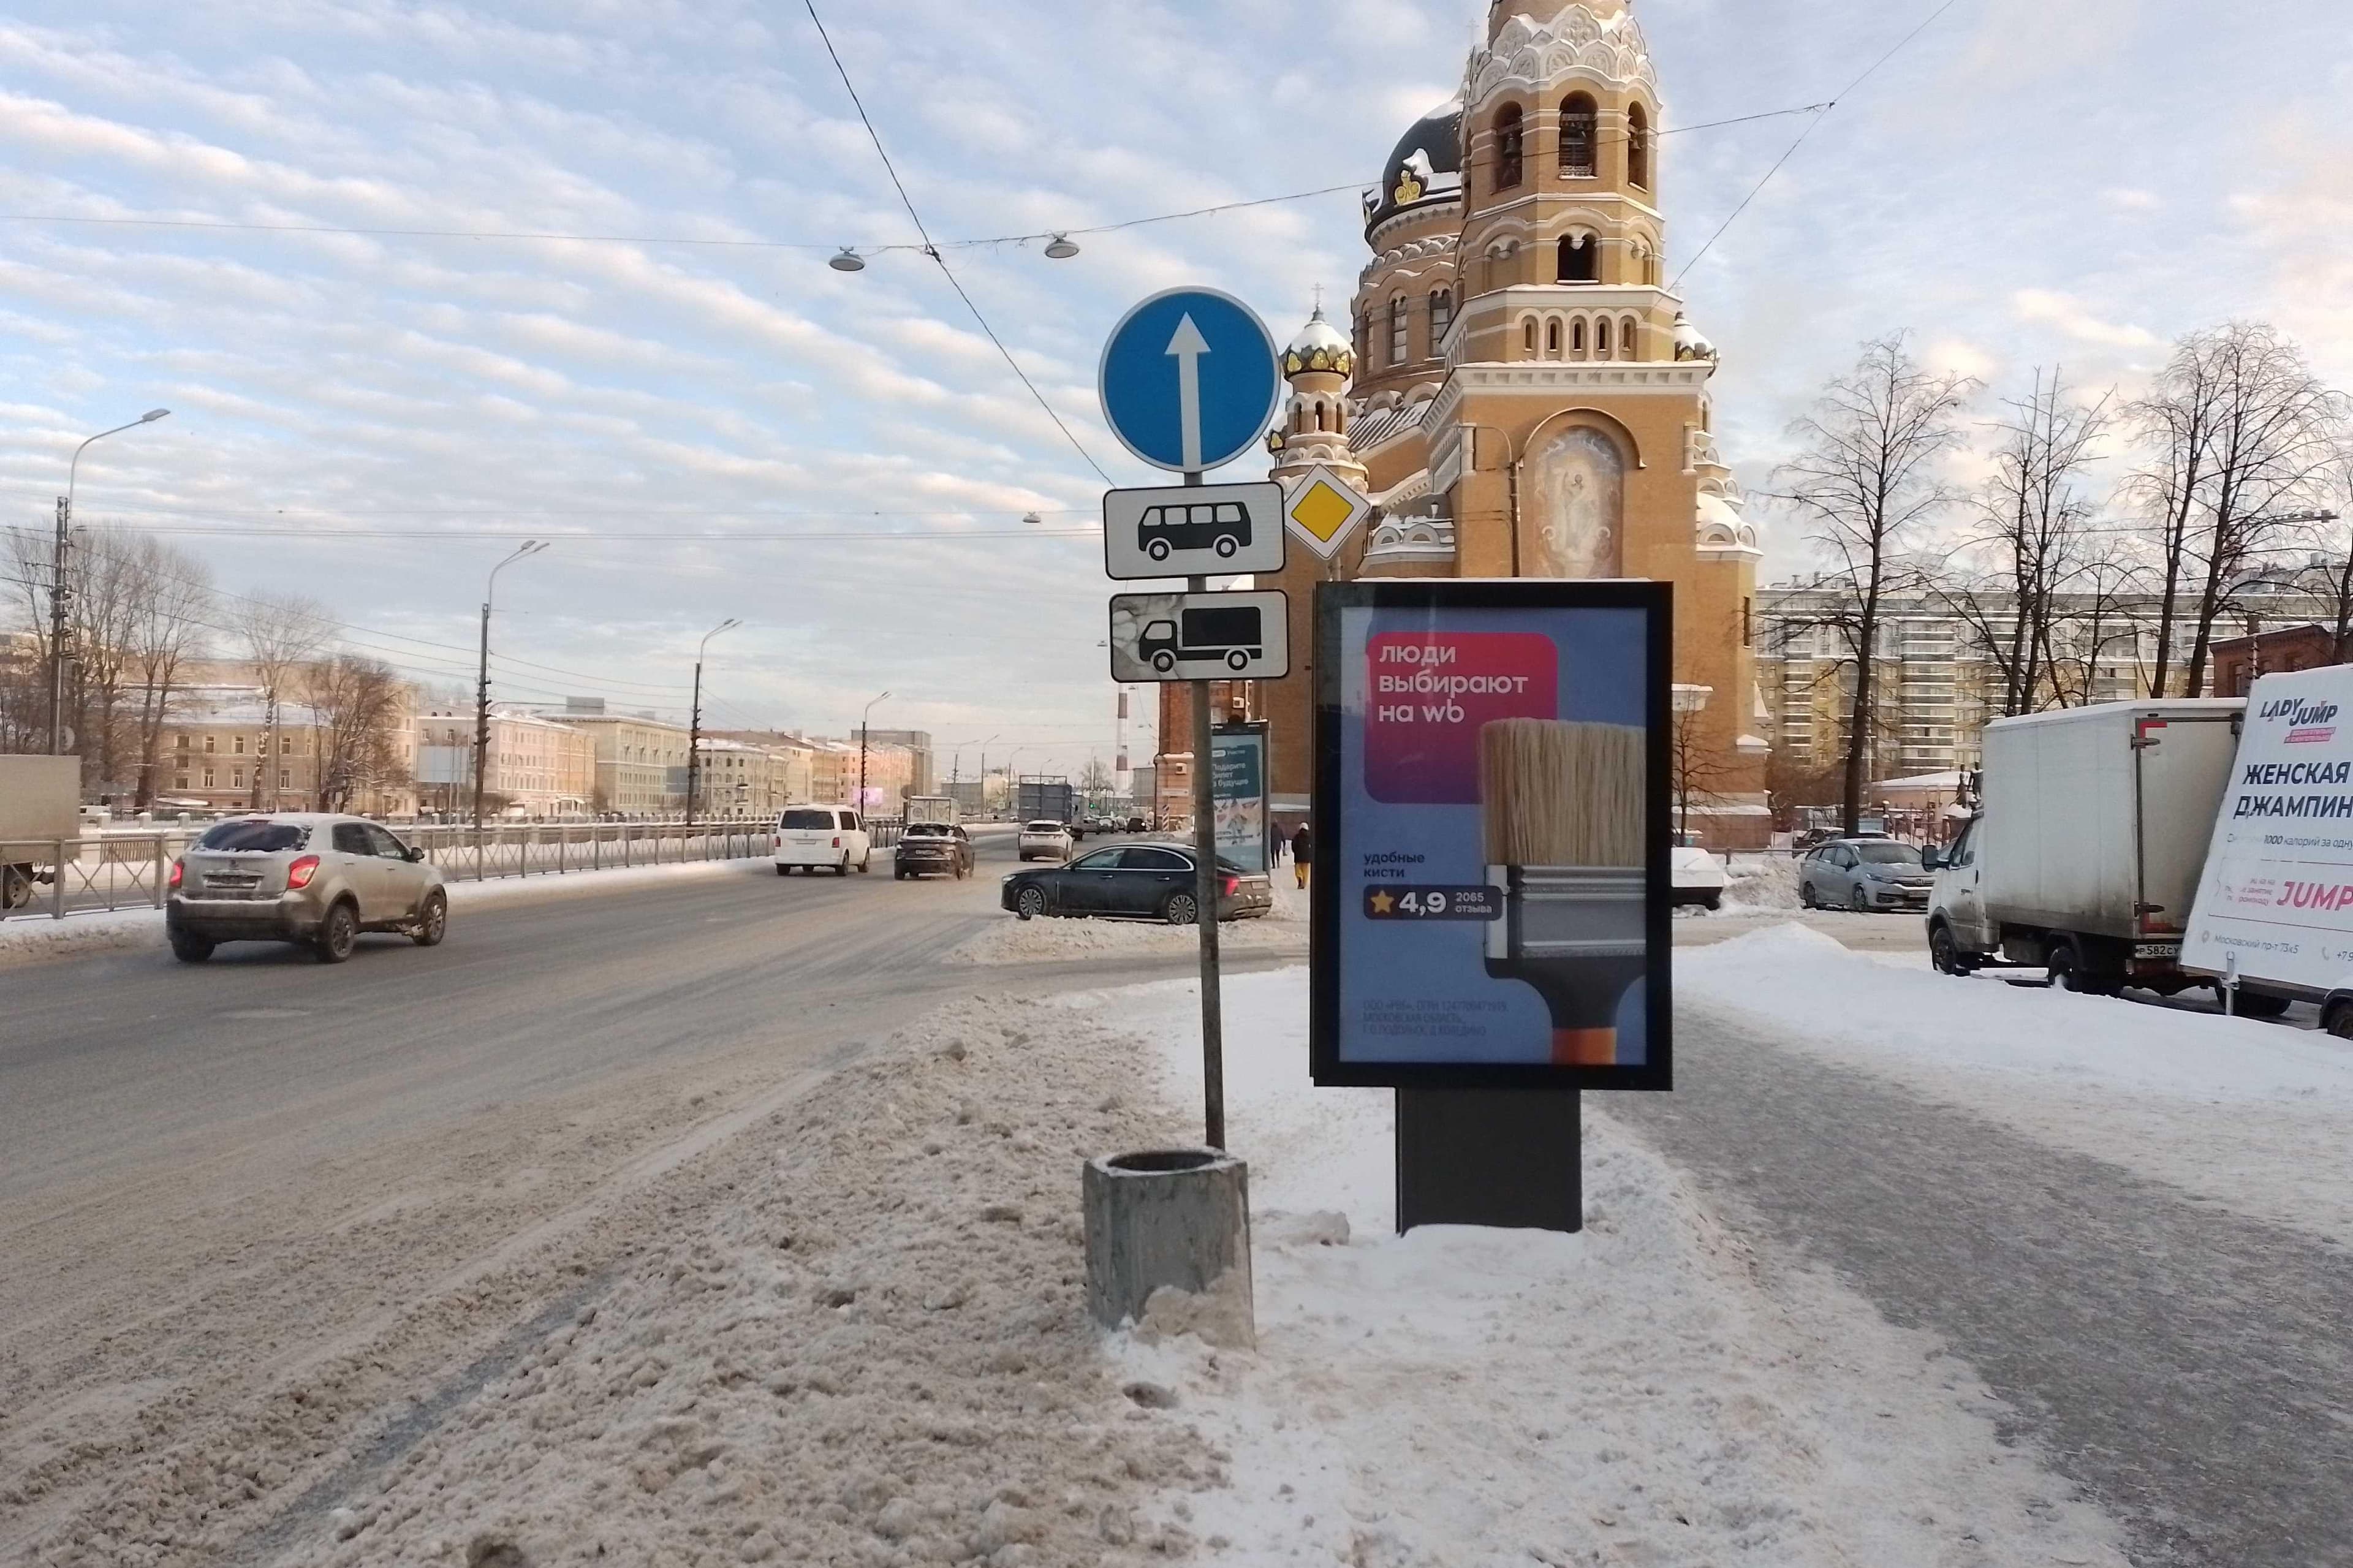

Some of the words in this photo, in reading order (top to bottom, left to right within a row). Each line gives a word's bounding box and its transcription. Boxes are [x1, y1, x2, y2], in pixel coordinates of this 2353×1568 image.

[1379, 645, 1456, 666] люди
[1379, 670, 1528, 698] выбирают
[1379, 705, 1414, 722] на
[1422, 699, 1464, 723] wb
[2259, 698, 2305, 719] LADY
[2289, 704, 2338, 727] JUMP
[2241, 761, 2352, 785] ЖЕНСКАЯ
[2232, 795, 2353, 820] ДЖАМПИН
[2264, 835, 2283, 845] 1000
[2284, 835, 2321, 848] калорий
[2322, 838, 2331, 847] за
[1363, 851, 1425, 865] удобные
[1363, 868, 1405, 878] кисти
[1398, 892, 1447, 917] 4,9
[2276, 881, 2353, 911] JUMP
[2215, 934, 2260, 949] Московский
